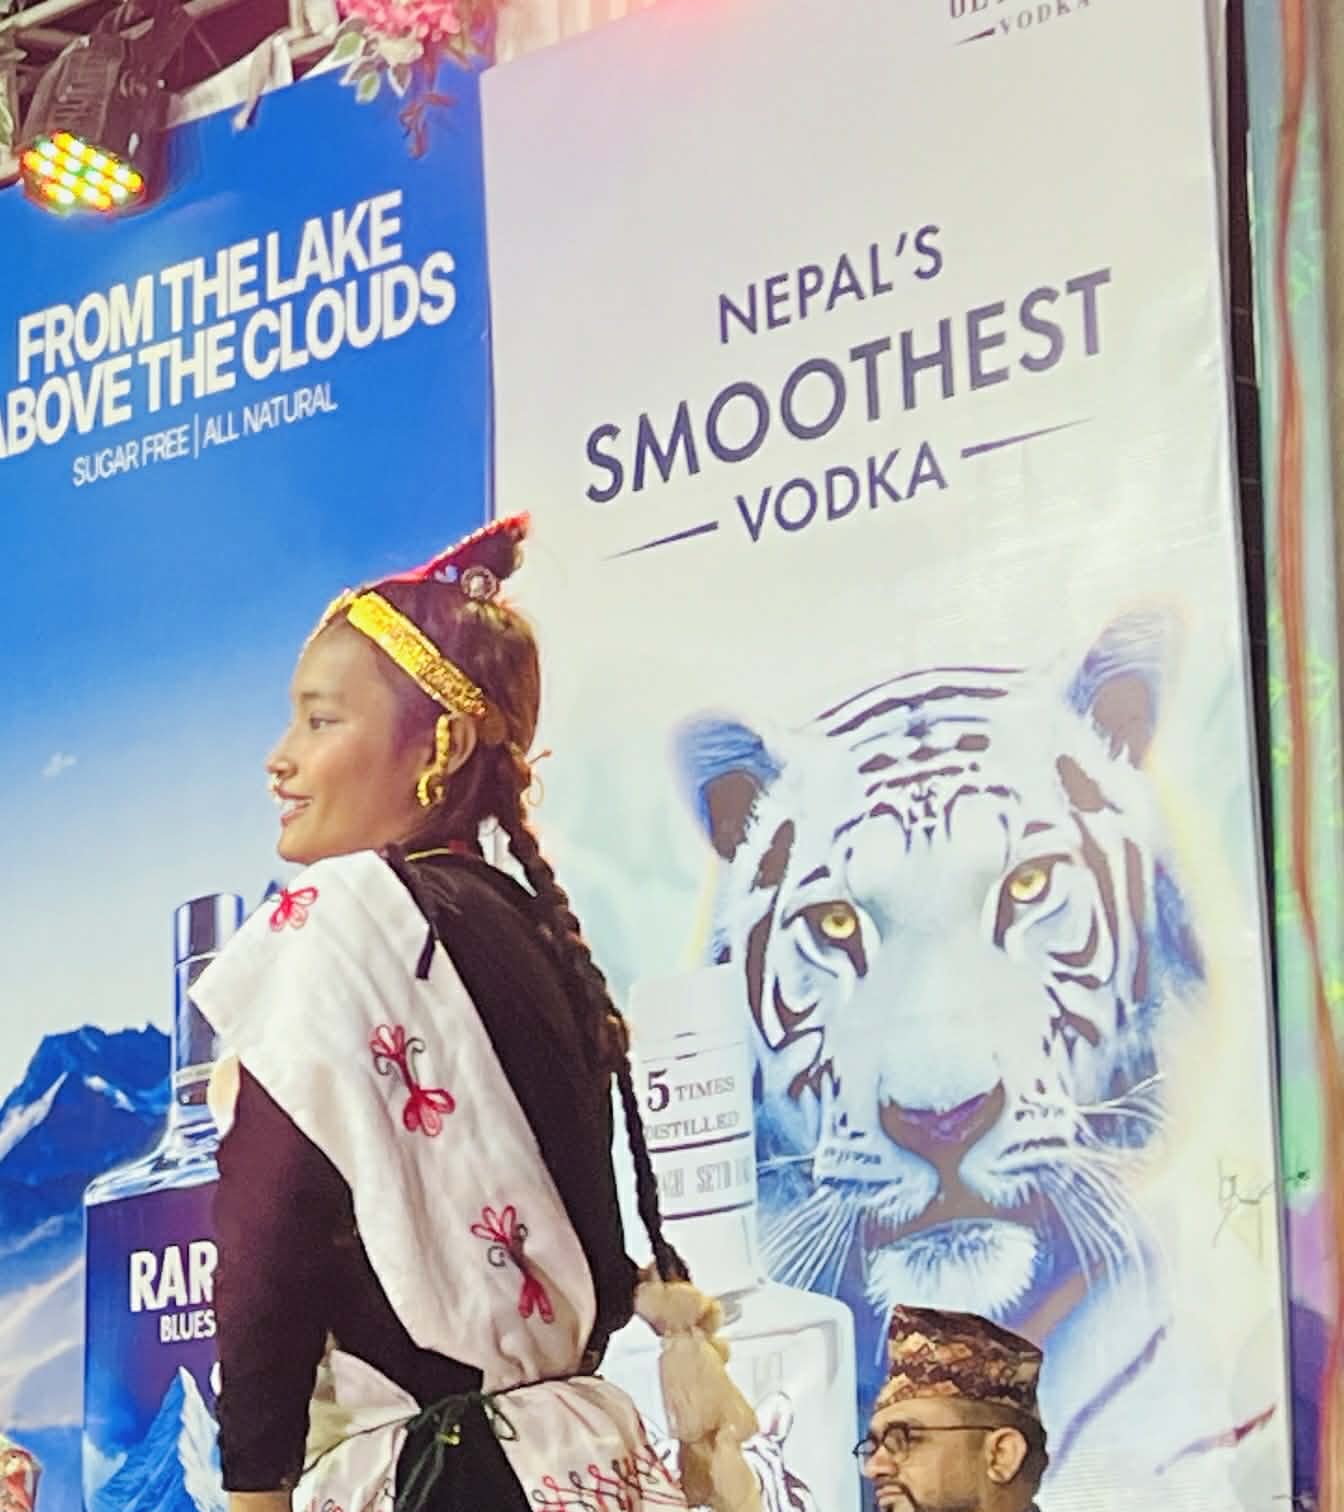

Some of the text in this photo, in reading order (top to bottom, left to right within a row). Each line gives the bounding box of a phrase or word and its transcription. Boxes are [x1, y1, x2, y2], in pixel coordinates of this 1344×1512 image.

[17, 188, 403, 383] FROM THE LAKE
[138, 319, 237, 413] THE
[242, 250, 456, 381] CLOUDS
[718, 224, 944, 345] NEPAL'S
[73, 382, 338, 488] SUGAR FREE ALL NATURAL
[585, 267, 1112, 503] SMOOTHEST
[736, 440, 949, 543] VODKA
[647, 1068, 736, 1113] 5 TIMES
[129, 1241, 219, 1313] RAR
[160, 1308, 217, 1343] BLUES
